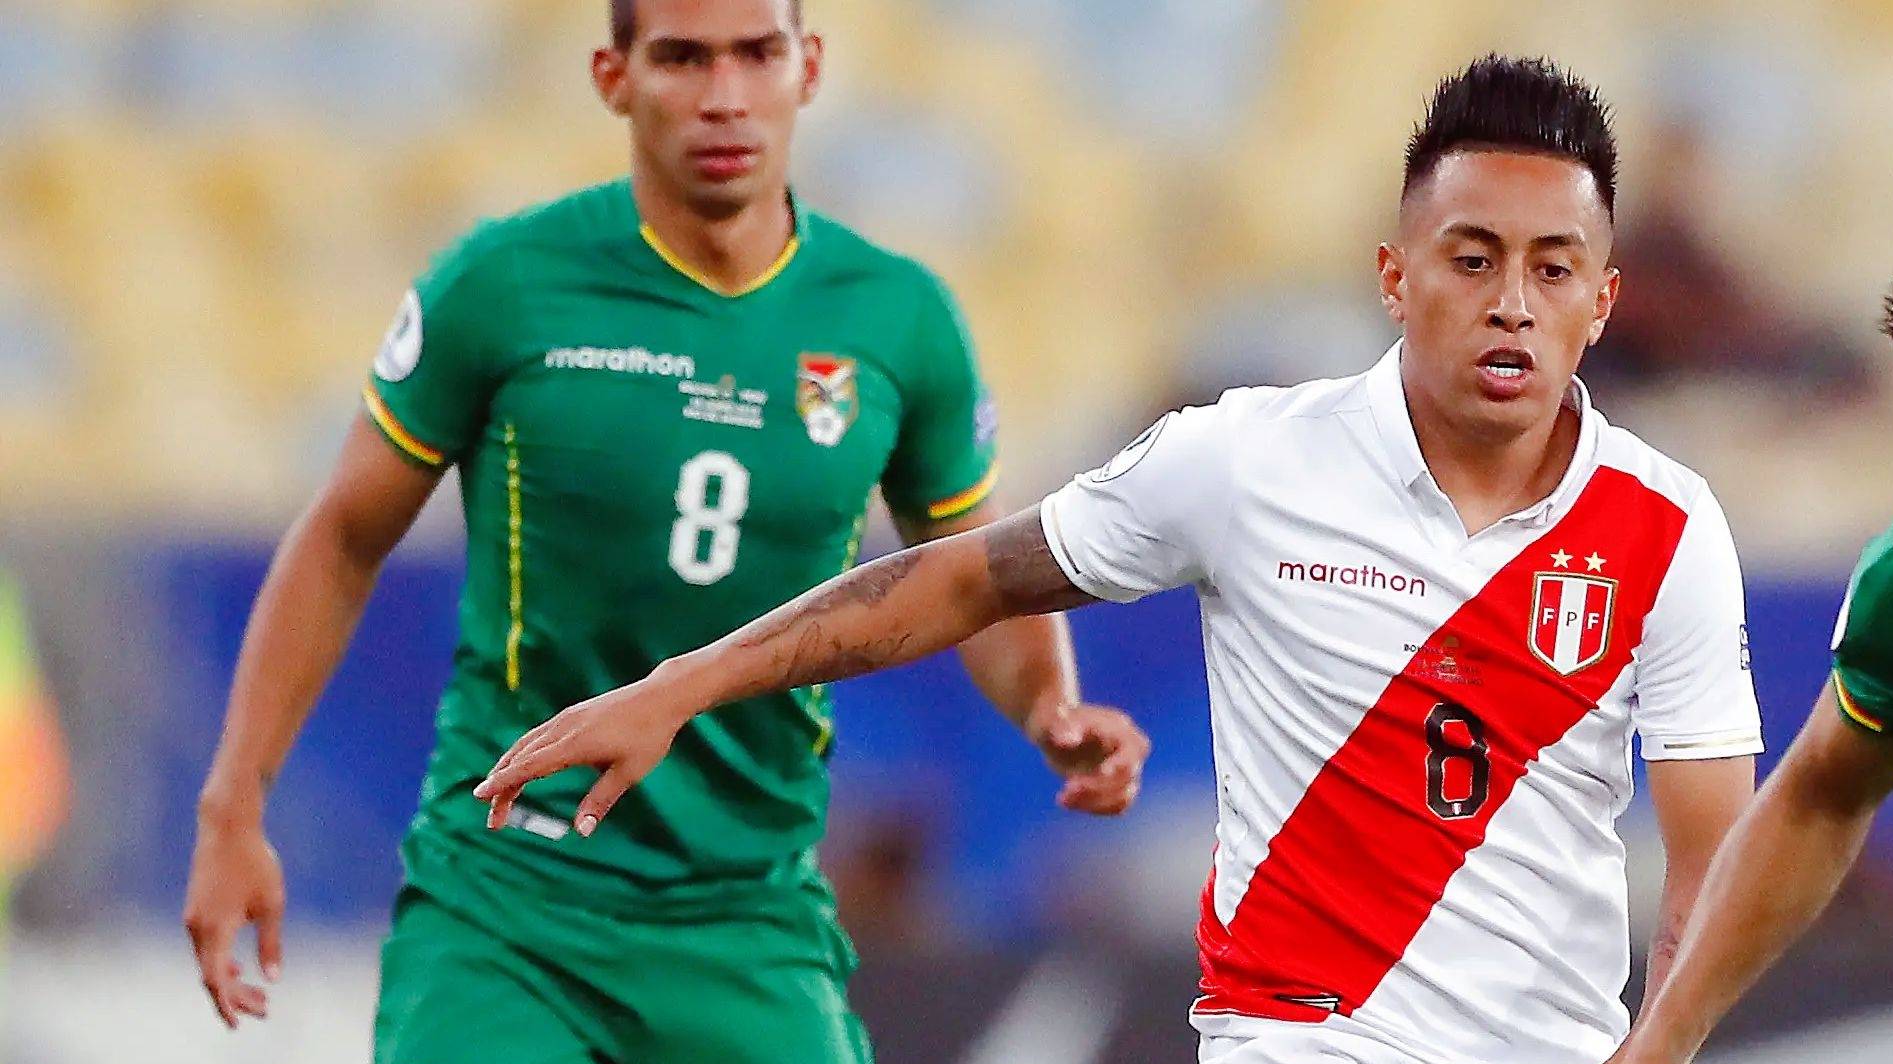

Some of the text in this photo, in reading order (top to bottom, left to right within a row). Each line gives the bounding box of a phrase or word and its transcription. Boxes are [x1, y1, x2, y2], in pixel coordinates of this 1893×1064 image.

[545, 345, 695, 379] marathon
[667, 450, 749, 586] 8
[1278, 560, 1426, 597] marathon
[1423, 702, 1492, 820] 8
